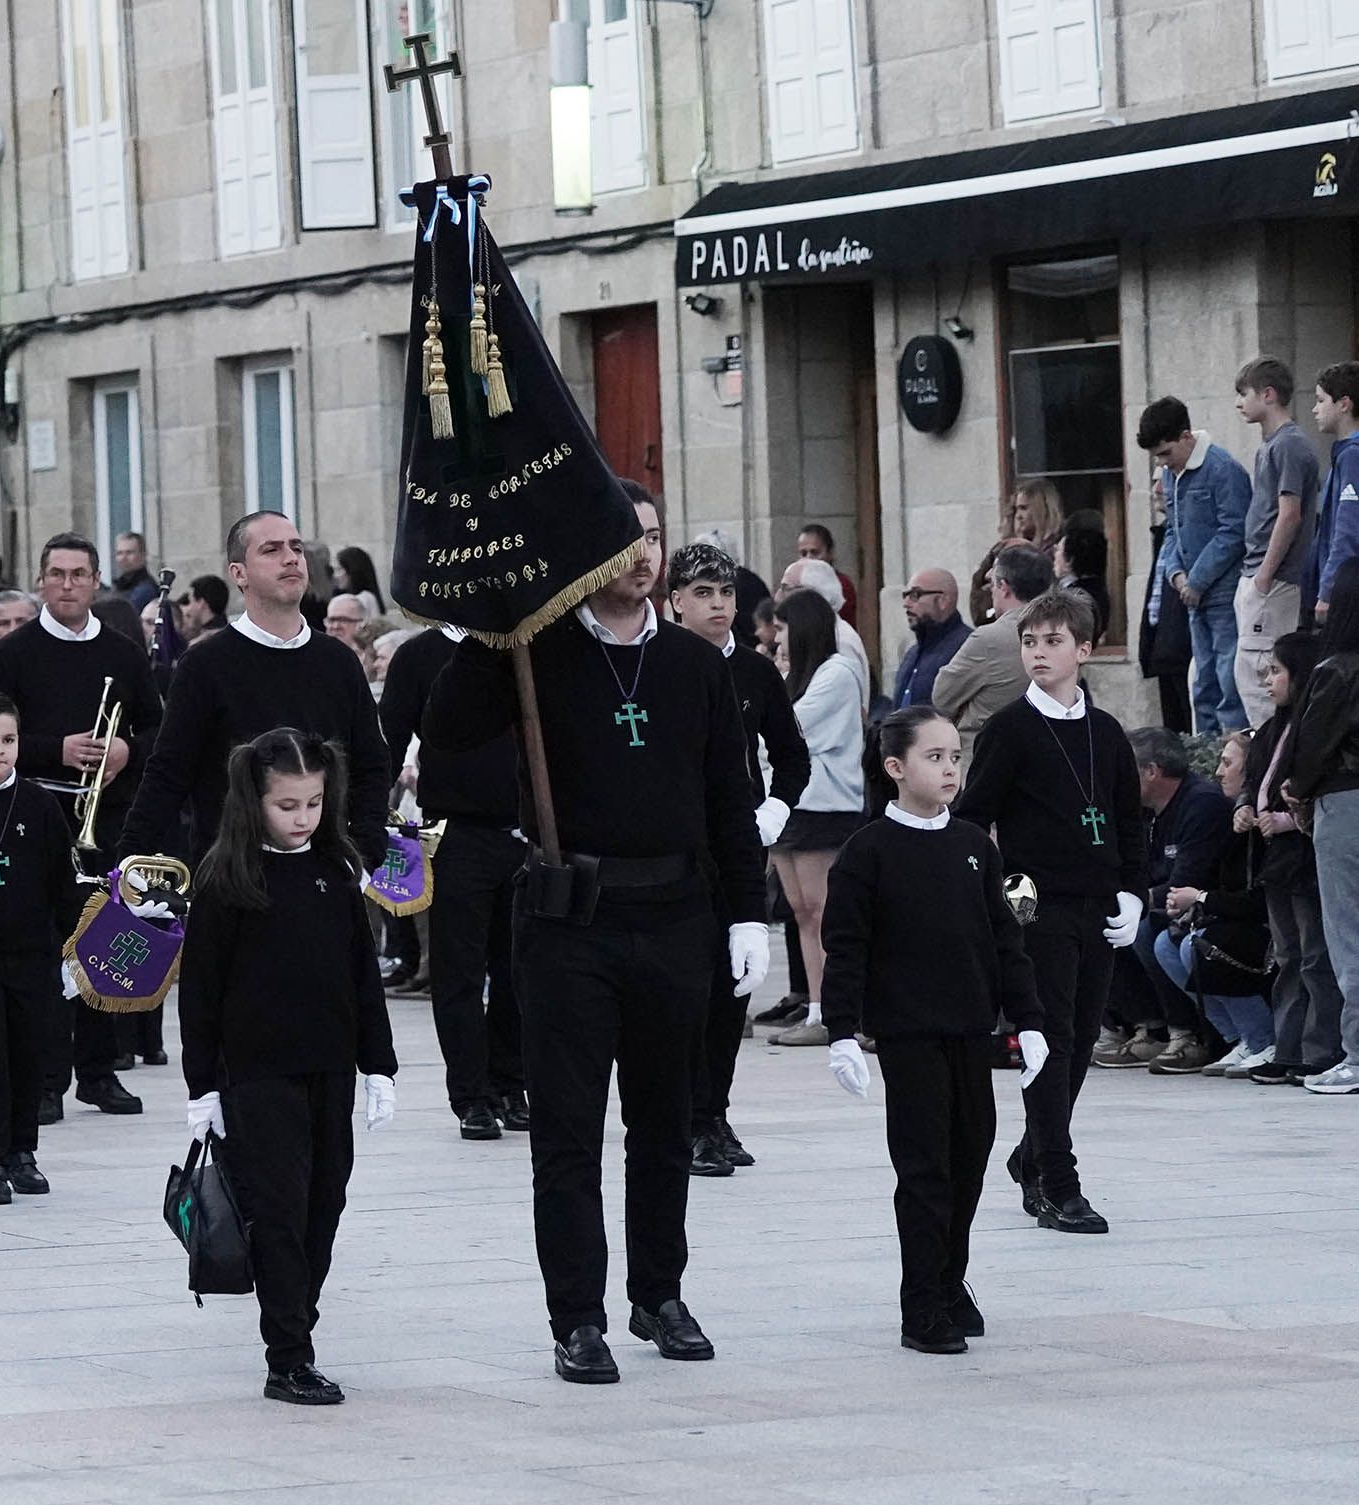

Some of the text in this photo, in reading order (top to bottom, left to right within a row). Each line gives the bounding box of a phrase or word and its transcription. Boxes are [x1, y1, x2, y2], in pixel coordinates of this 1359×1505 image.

[692, 230, 790, 280] PADAL
[449, 493, 472, 508] DE
[488, 442, 572, 500] CORNETAS
[427, 533, 525, 567] TAMBORES
